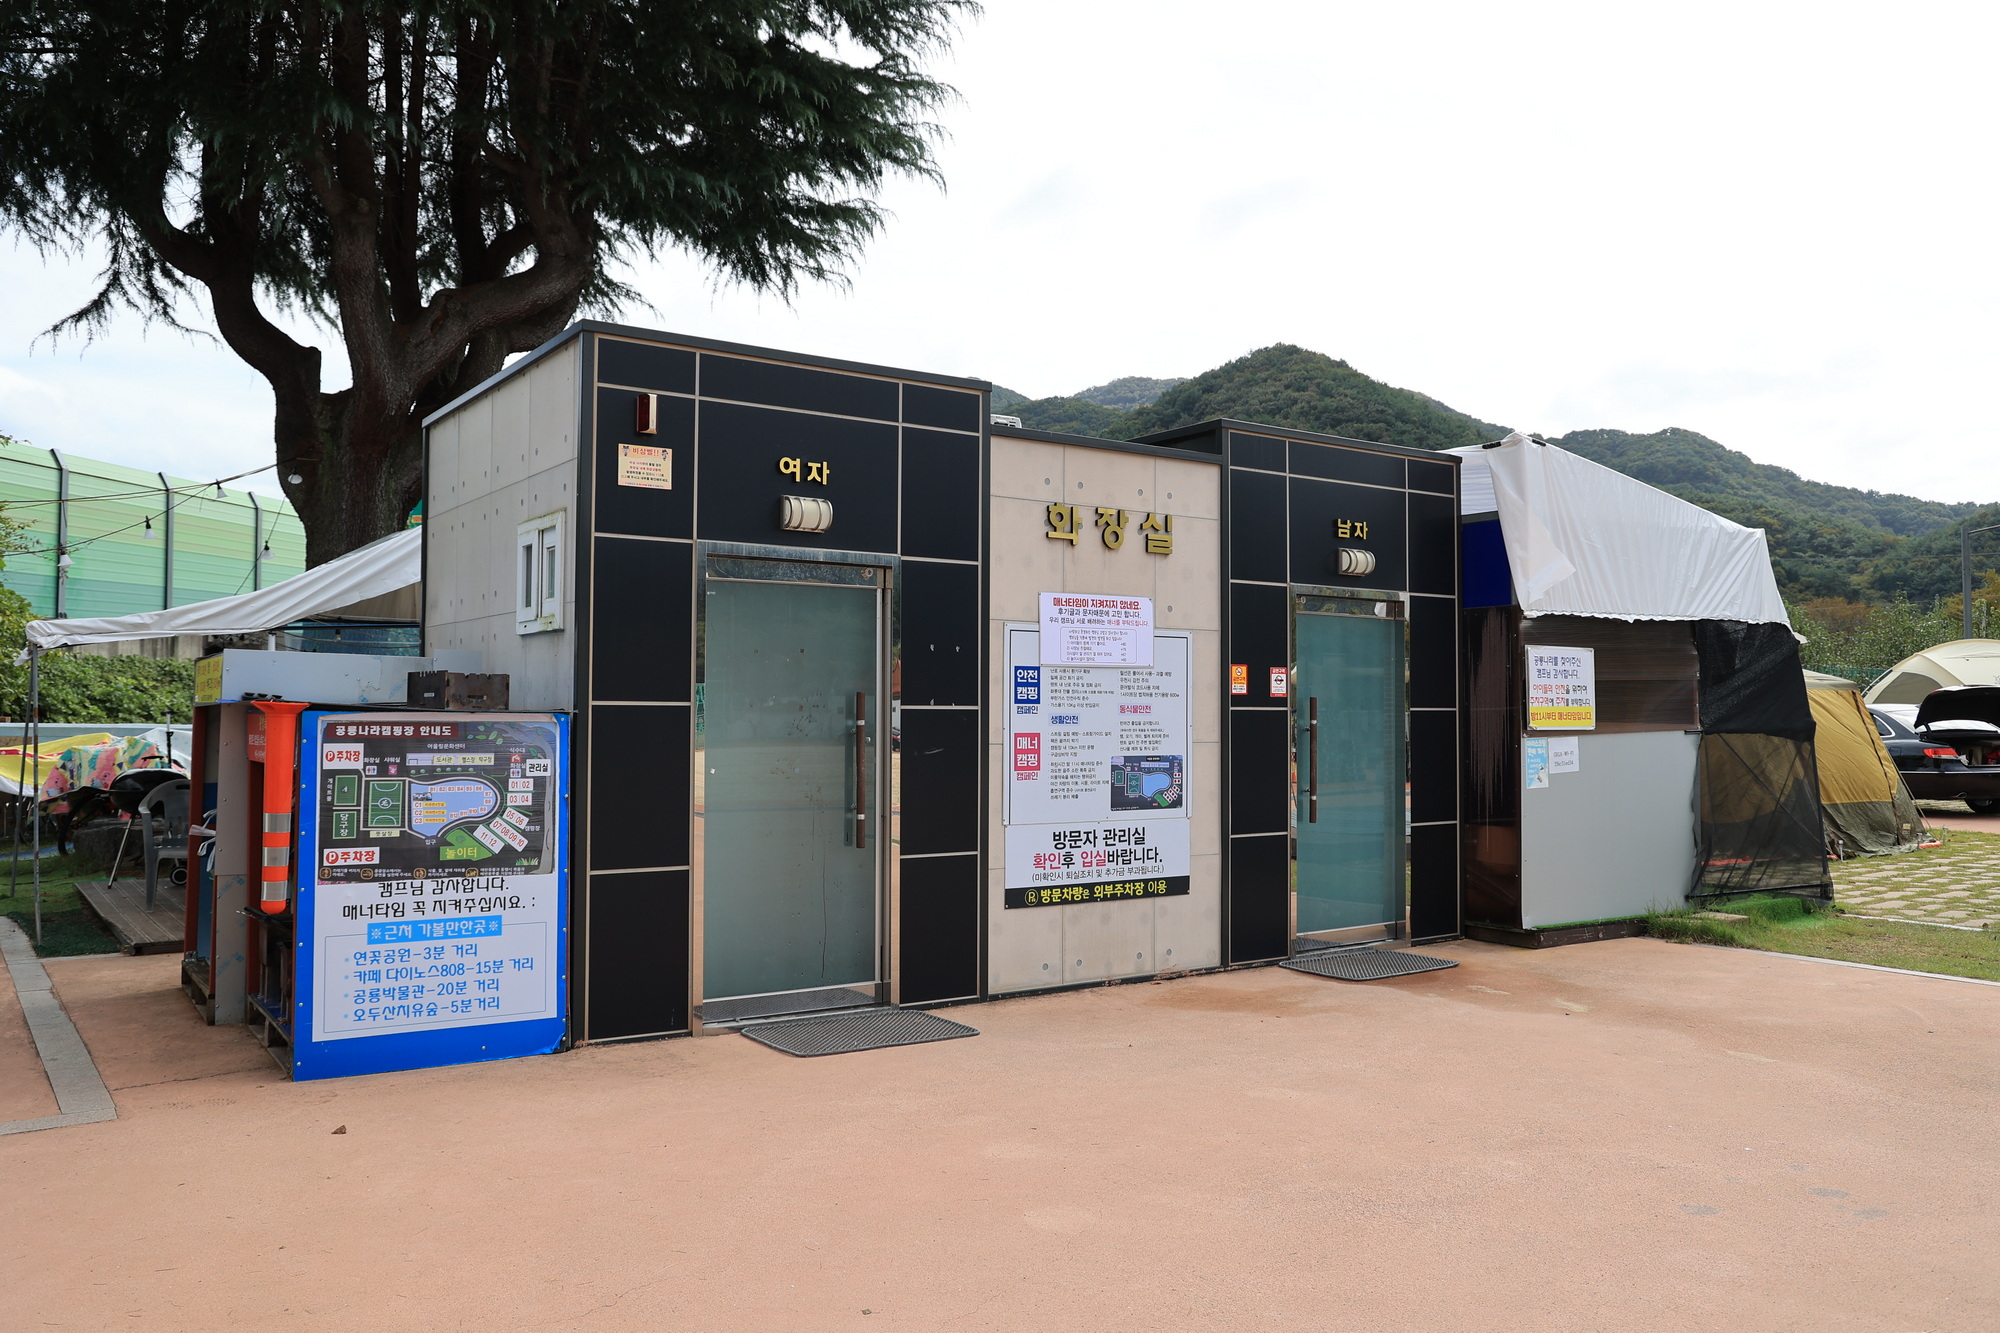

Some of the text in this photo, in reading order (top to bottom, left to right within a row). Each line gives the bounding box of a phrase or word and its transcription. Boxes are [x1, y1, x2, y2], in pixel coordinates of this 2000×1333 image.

[778, 456, 830, 485] 여자
[1046, 502, 1173, 555] 화장실
[1337, 518, 1368, 540] 남자
[1053, 597, 1141, 610] 매너타임이 지켜지지 않네요.
[1058, 608, 1141, 619] 후기글과 문자때문에 고민 합니다.
[1534, 655, 1581, 668] 공룡나라를 찾아주신
[1017, 669, 1038, 682] 안전
[1536, 668, 1580, 680] 캠프님 감사합니다.
[1017, 687, 1038, 700] 캠핑
[1532, 684, 1588, 695] 아이들의 안전을 위하여
[1017, 706, 1038, 714] 캠페인
[1119, 705, 1152, 714] 동식물안전
[1051, 715, 1079, 724] 생활안전
[335, 725, 452, 737] 공룡나라캠핑장 안내도
[1017, 737, 1038, 749] 매너
[336, 750, 361, 762] 주차장
[1017, 754, 1038, 767] 캠핑
[528, 763, 548, 772] 관리실
[1017, 772, 1038, 781] 캠페인
[511, 781, 518, 789] 01
[522, 781, 530, 789] 02
[509, 795, 518, 803] 03
[521, 795, 529, 803] 04
[506, 810, 515, 820] 05
[515, 816, 525, 825] 06
[339, 813, 349, 837] 당구장
[493, 821, 502, 830] 07
[480, 832, 489, 840] 11
[500, 827, 509, 836] 08
[508, 833, 517, 842] 09
[488, 838, 497, 847] 12
[516, 839, 525, 848] 10
[1052, 826, 1146, 850] 방문자 관리실
[340, 850, 375, 863] 주차장
[445, 847, 477, 859] 놀이터
[1033, 846, 1163, 870] 확인후 입실바랍니다.
[1032, 865, 1164, 882] (미확인시 퇴실조치 및 추가금 부과됩니다.)
[378, 881, 423, 898] 캠프님
[1040, 880, 1167, 904] 방문차량은 외부주차장 이용
[342, 895, 526, 921] 매너타임 꼭 지켜주십시요.
[353, 943, 478, 967] 연꽃공원-3분 거리
[353, 957, 534, 984] 카페 다이노스808-15분 거리
[353, 978, 500, 1005] 공룡박물관-20분 거리
